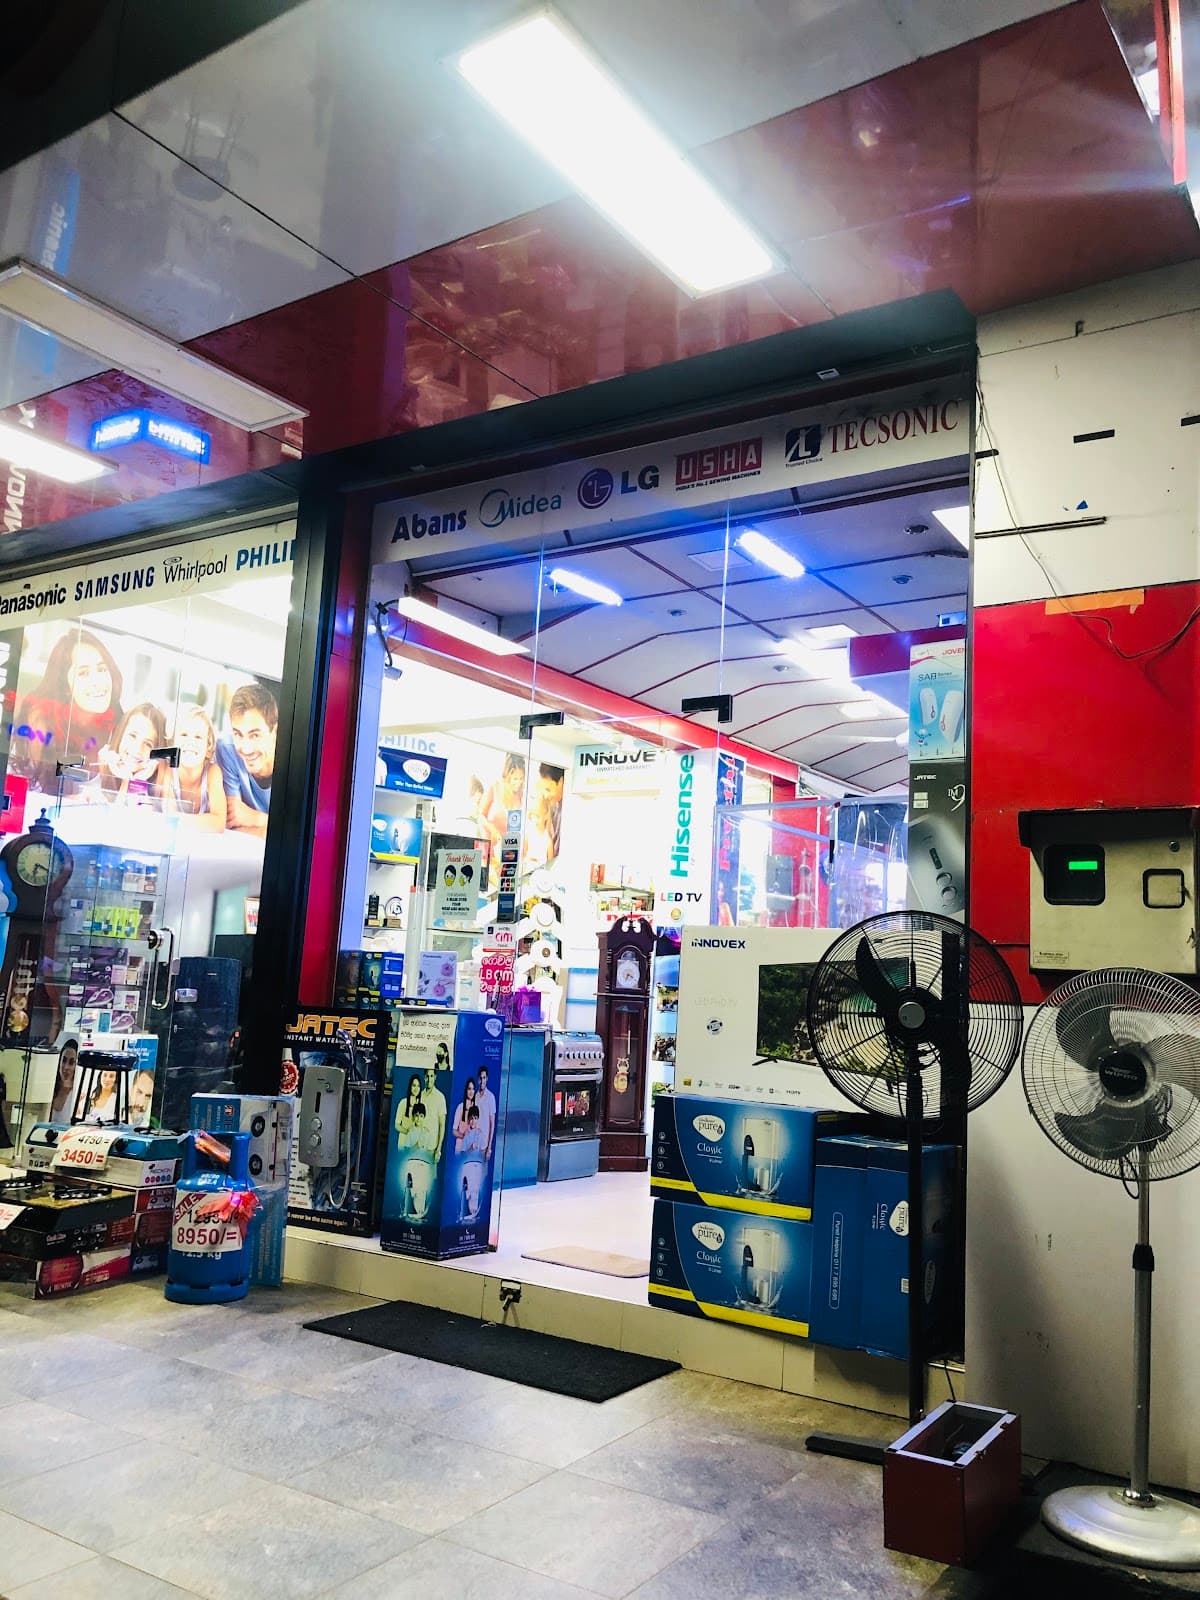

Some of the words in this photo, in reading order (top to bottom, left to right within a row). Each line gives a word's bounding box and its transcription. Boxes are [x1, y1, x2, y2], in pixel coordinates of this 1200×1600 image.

[828, 400, 959, 453] TECSONIC
[680, 442, 758, 480] USHA
[620, 465, 660, 494] LG
[490, 489, 562, 524] Midea
[391, 509, 467, 543] Abans
[164, 554, 229, 584] Whirlpool
[74, 566, 155, 601] SAMSUNG
[670, 754, 695, 877] Hisense
[660, 892, 683, 903] LED
[686, 892, 702, 903] TV
[691, 938, 746, 949] INNOVEX
[284, 1034, 313, 1042] INSTANT
[285, 1013, 378, 1039] JATEC
[61, 1148, 105, 1165] 3450/=
[697, 1143, 723, 1155] Classic
[174, 1193, 199, 1220] SALE
[176, 1227, 237, 1245] 8950/=
[696, 1250, 722, 1264] Classic
